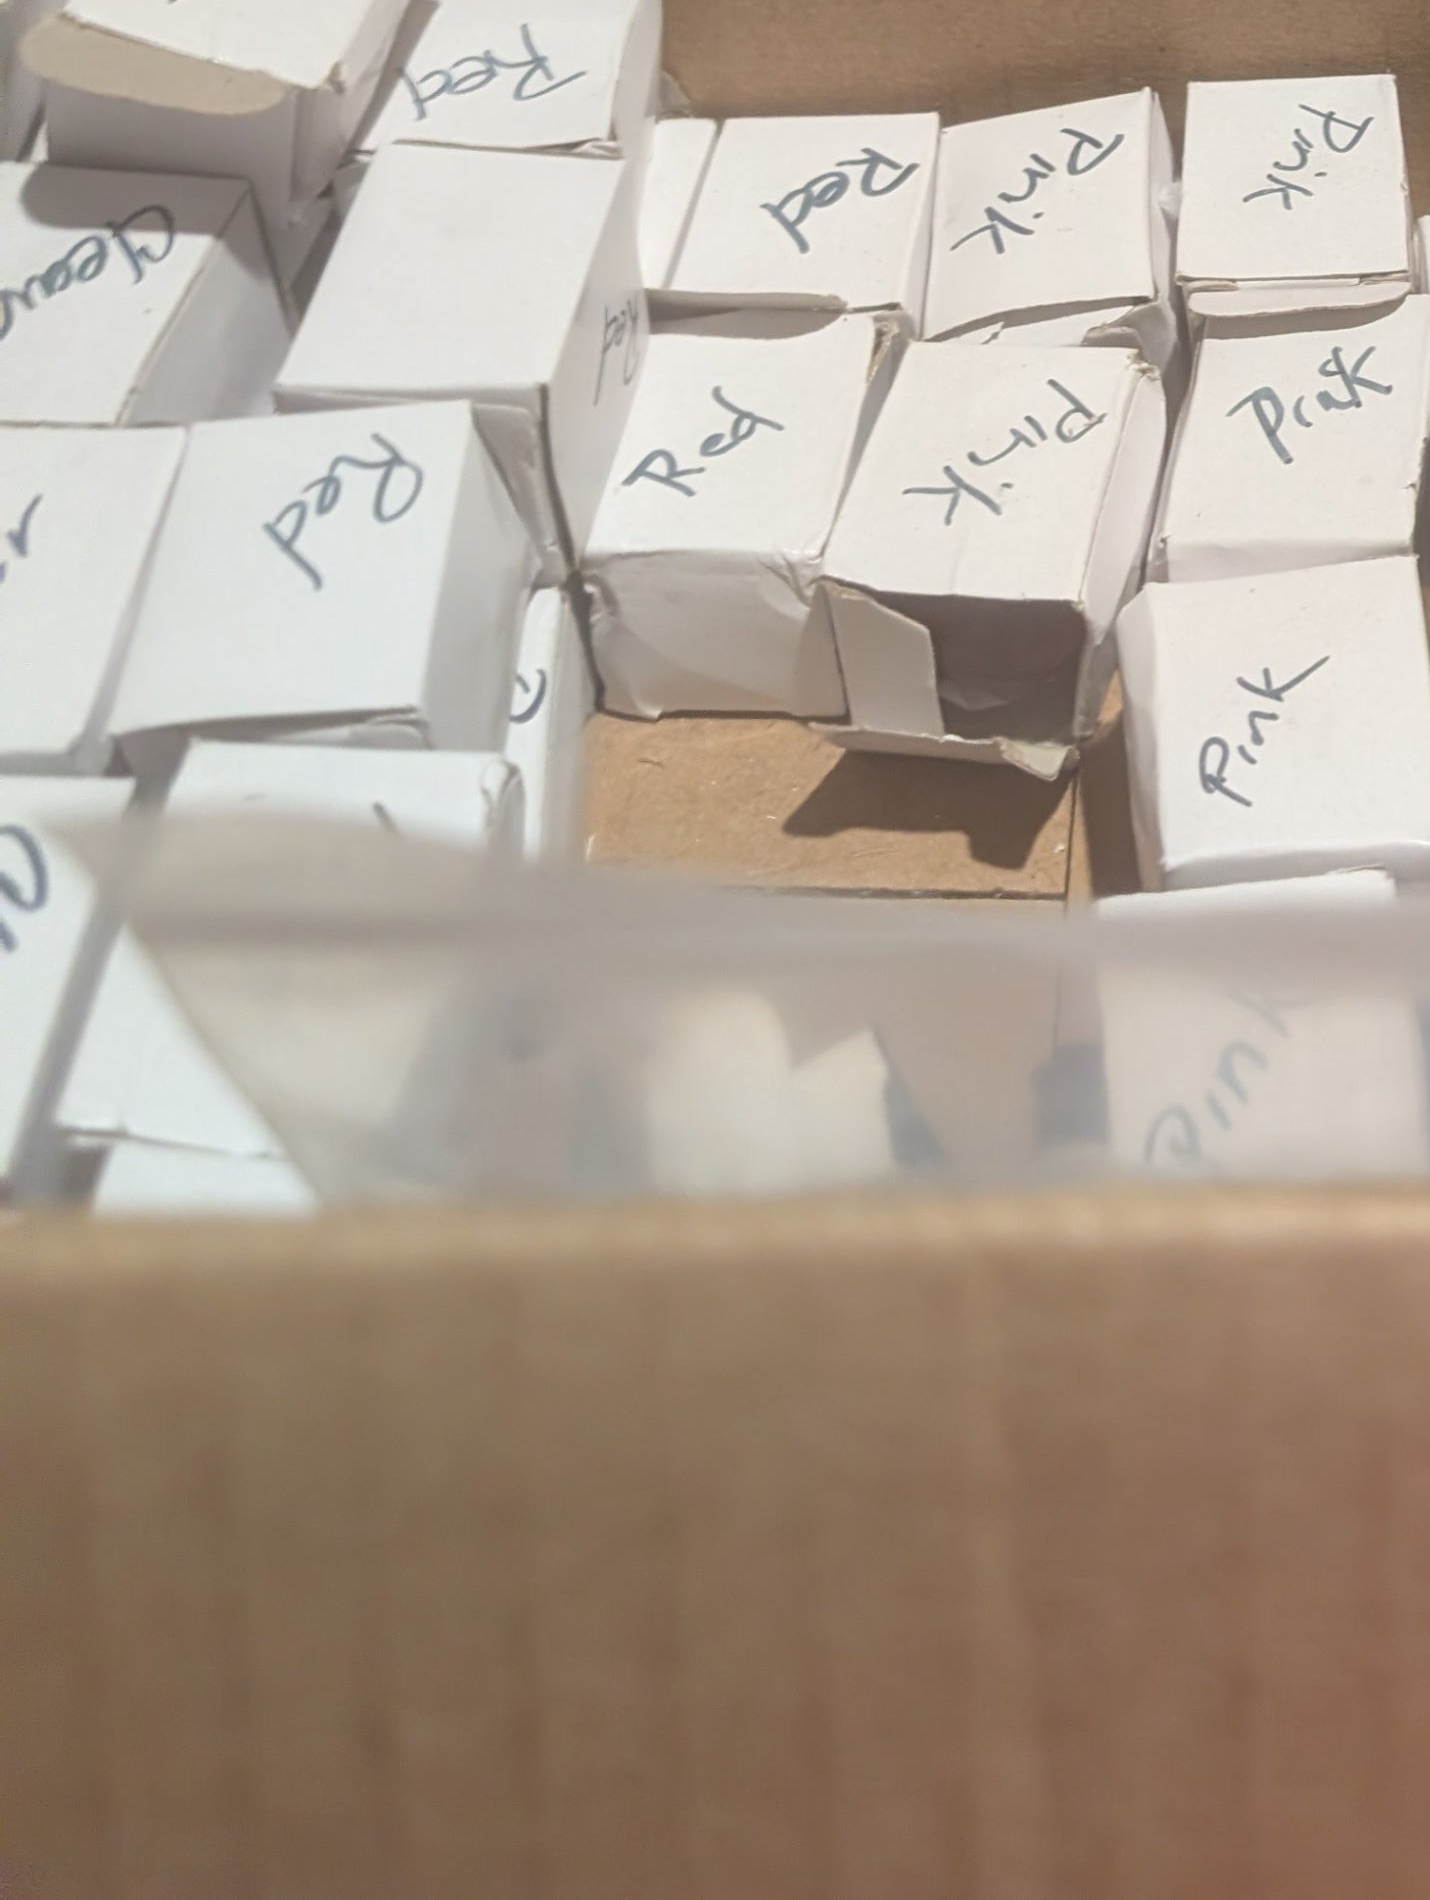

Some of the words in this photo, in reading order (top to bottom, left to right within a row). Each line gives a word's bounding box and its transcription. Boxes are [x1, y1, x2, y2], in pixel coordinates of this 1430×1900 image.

[398, 22, 588, 121] Red
[759, 146, 920, 254] Red
[949, 127, 1126, 254] Pink
[1241, 103, 1376, 211] Pink
[620, 385, 786, 498] Red
[901, 378, 1108, 526] Pink
[262, 432, 424, 591] Red
[1199, 655, 1331, 807] Pink
